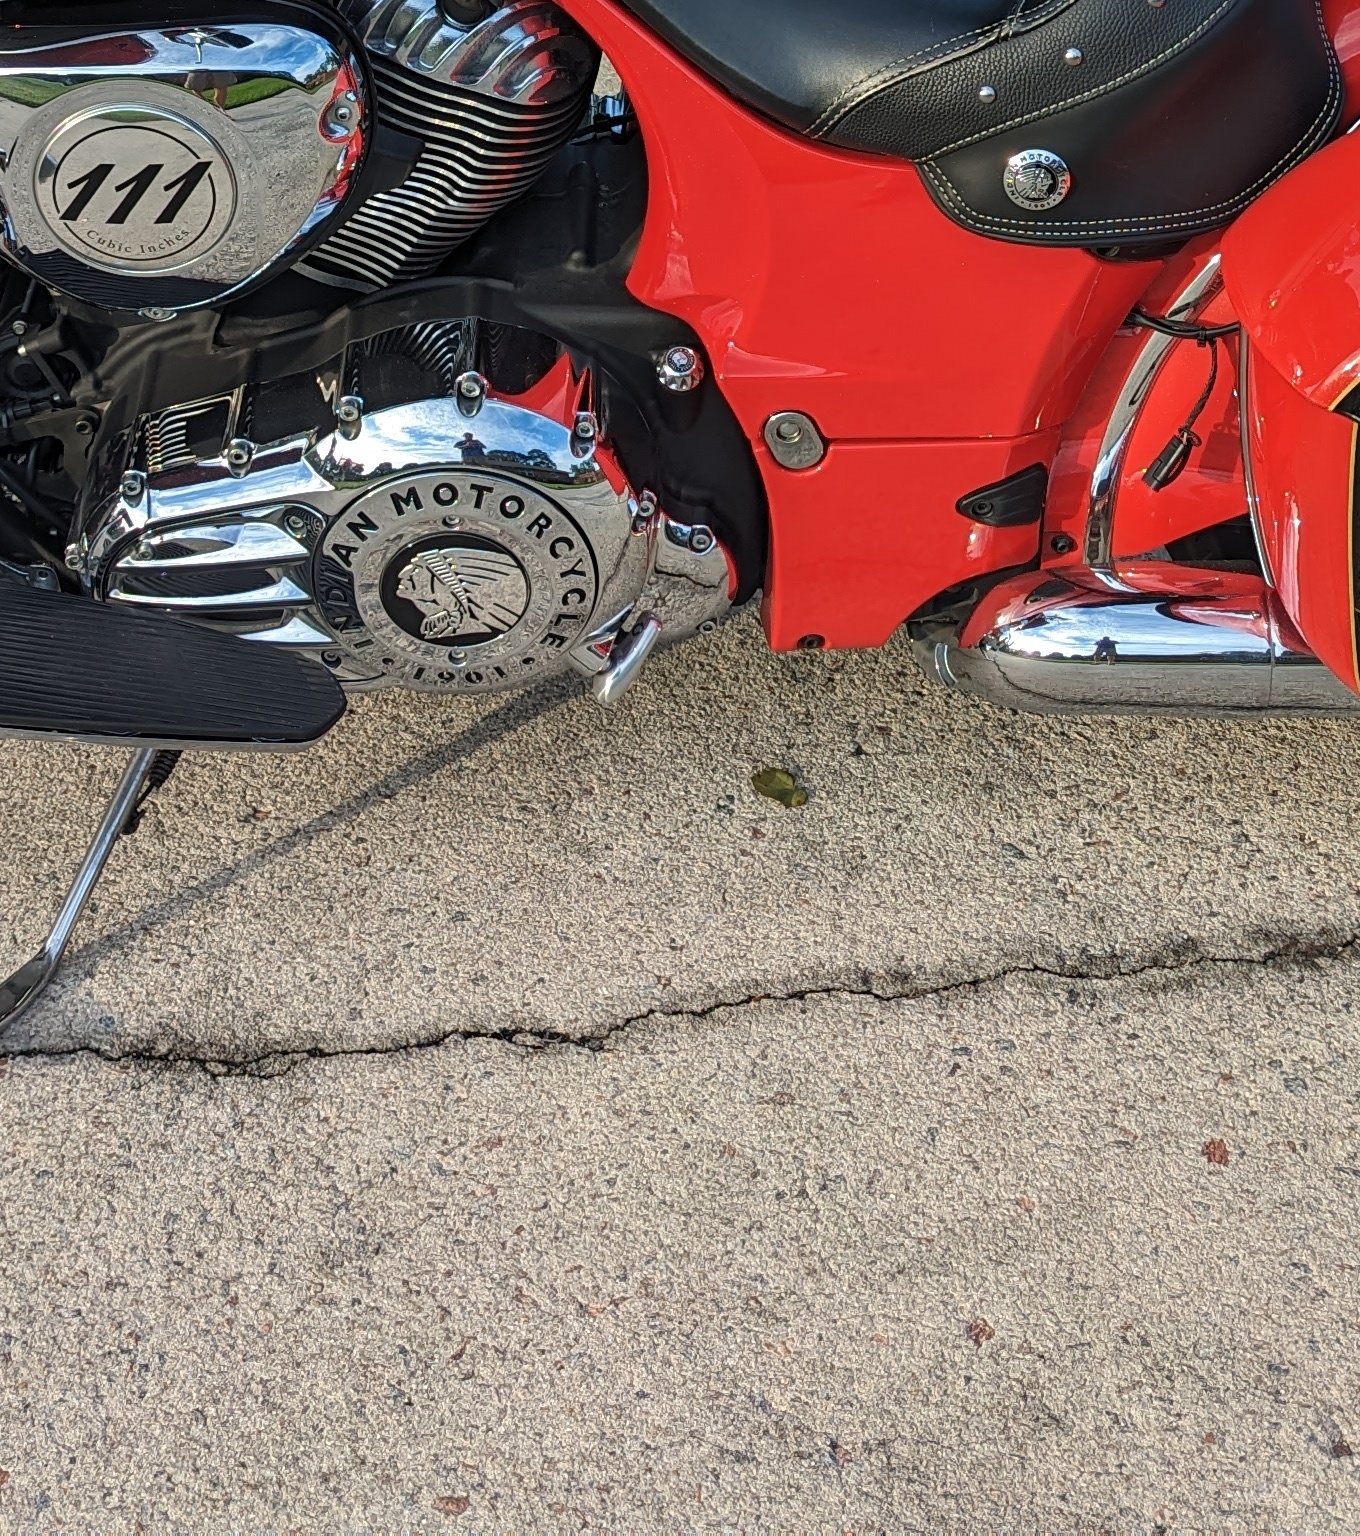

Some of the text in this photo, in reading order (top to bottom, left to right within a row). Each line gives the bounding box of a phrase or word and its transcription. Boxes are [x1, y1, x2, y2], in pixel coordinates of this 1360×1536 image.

[60, 161, 213, 224] 111
[87, 229, 190, 253] Cubic Inches
[325, 482, 587, 651] INDIAN MOTORCYCLE
[413, 666, 508, 684] 1901
